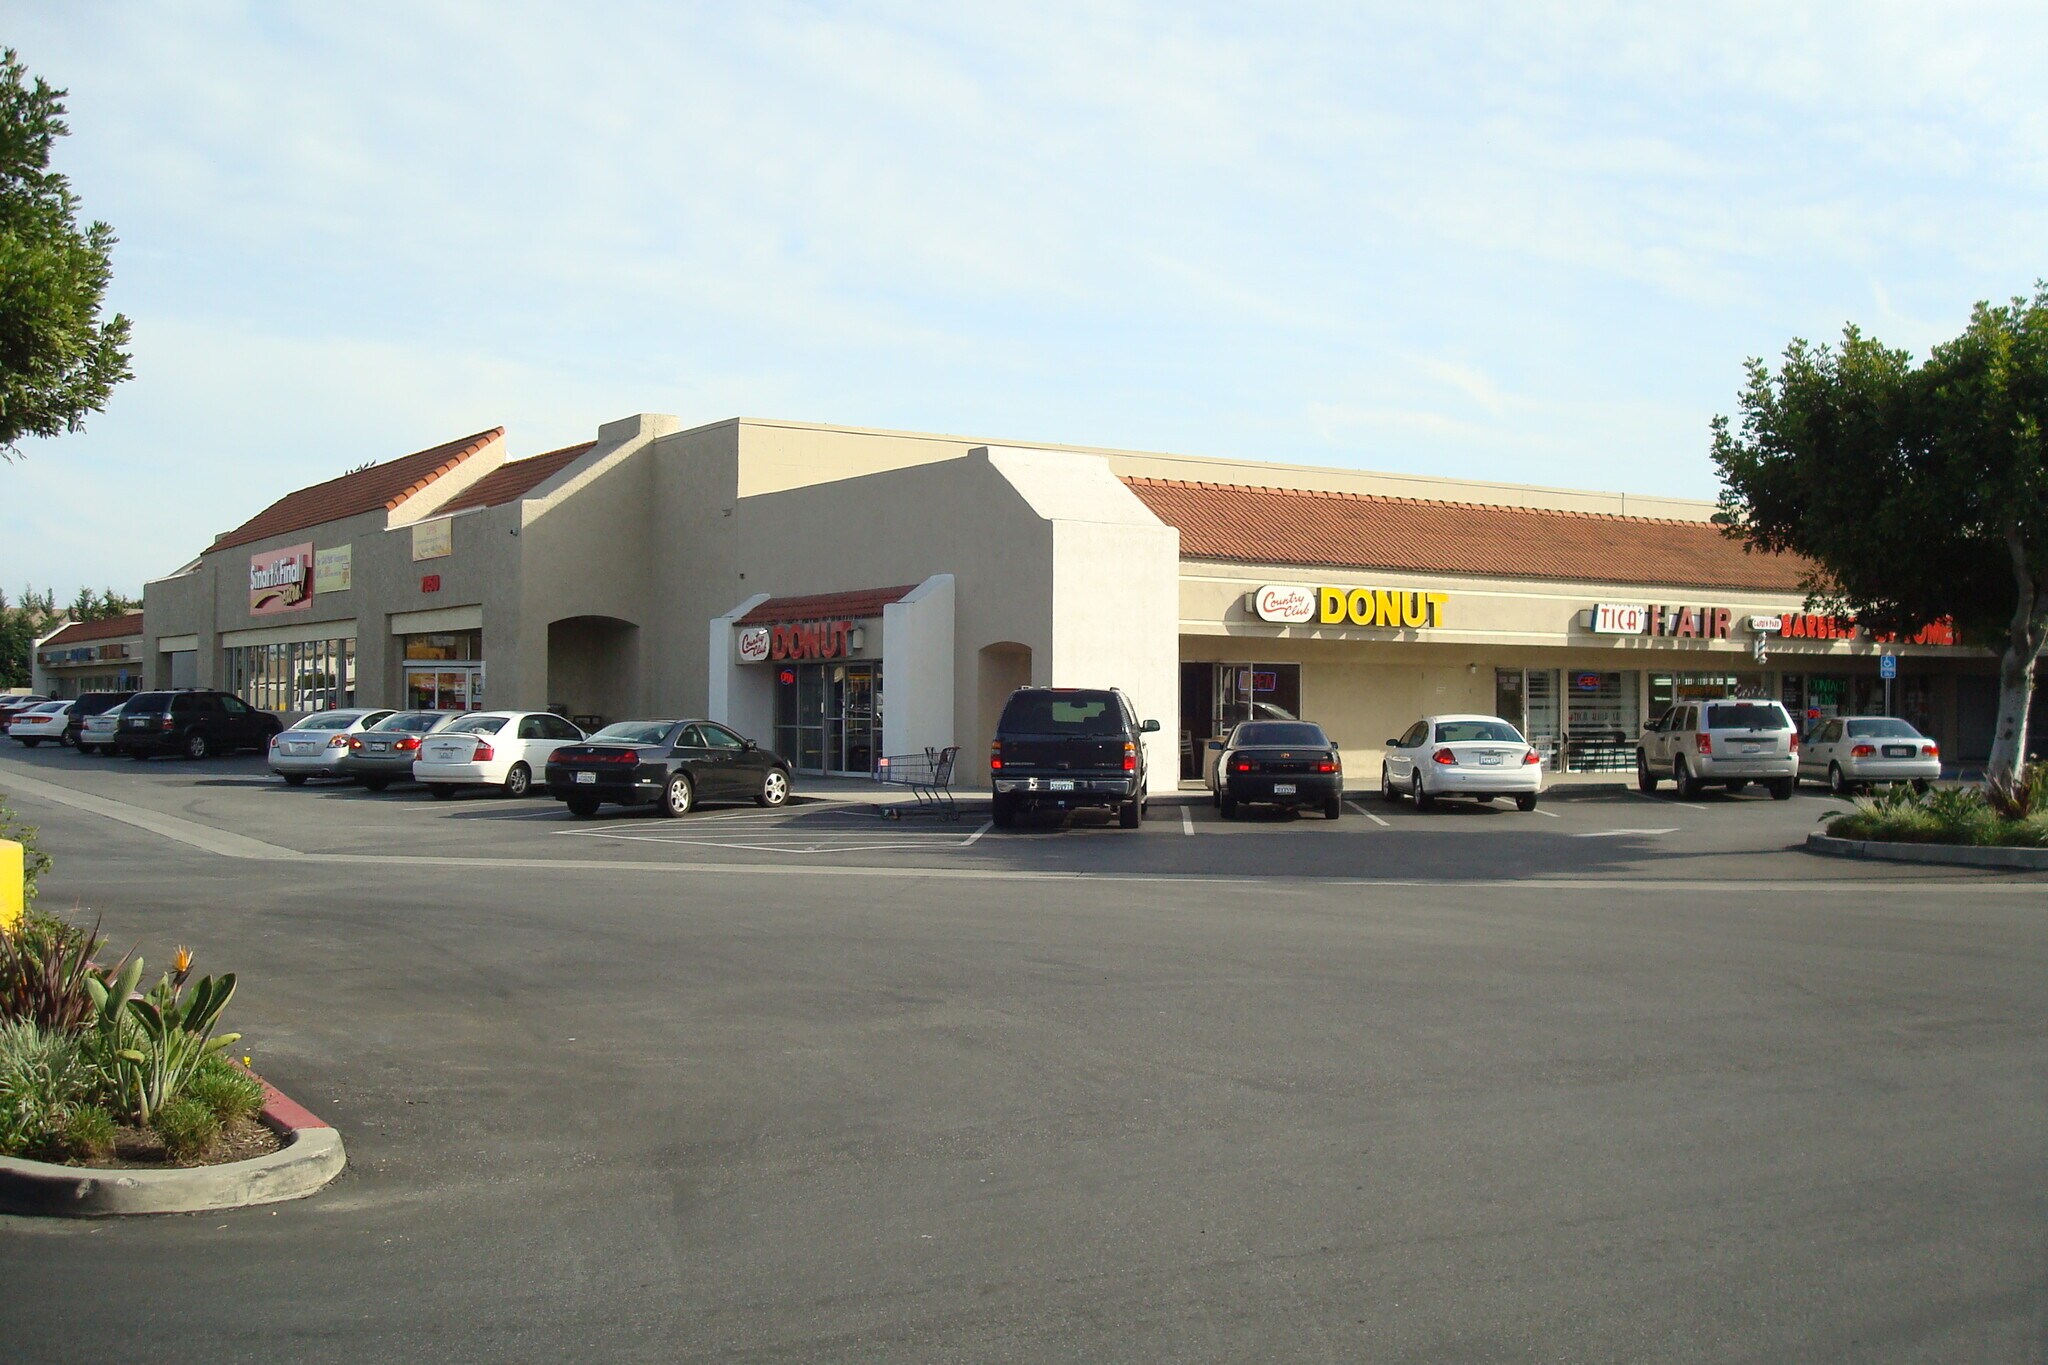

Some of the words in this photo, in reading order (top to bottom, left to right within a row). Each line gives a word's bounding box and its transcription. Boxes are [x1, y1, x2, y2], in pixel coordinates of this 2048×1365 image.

[1263, 591, 1305, 613] Country
[1284, 603, 1310, 617] Club
[1320, 587, 1450, 628] DONUT
[1601, 608, 1637, 631] TICA
[1652, 604, 1732, 640] HAIR
[772, 621, 853, 660] DONUT
